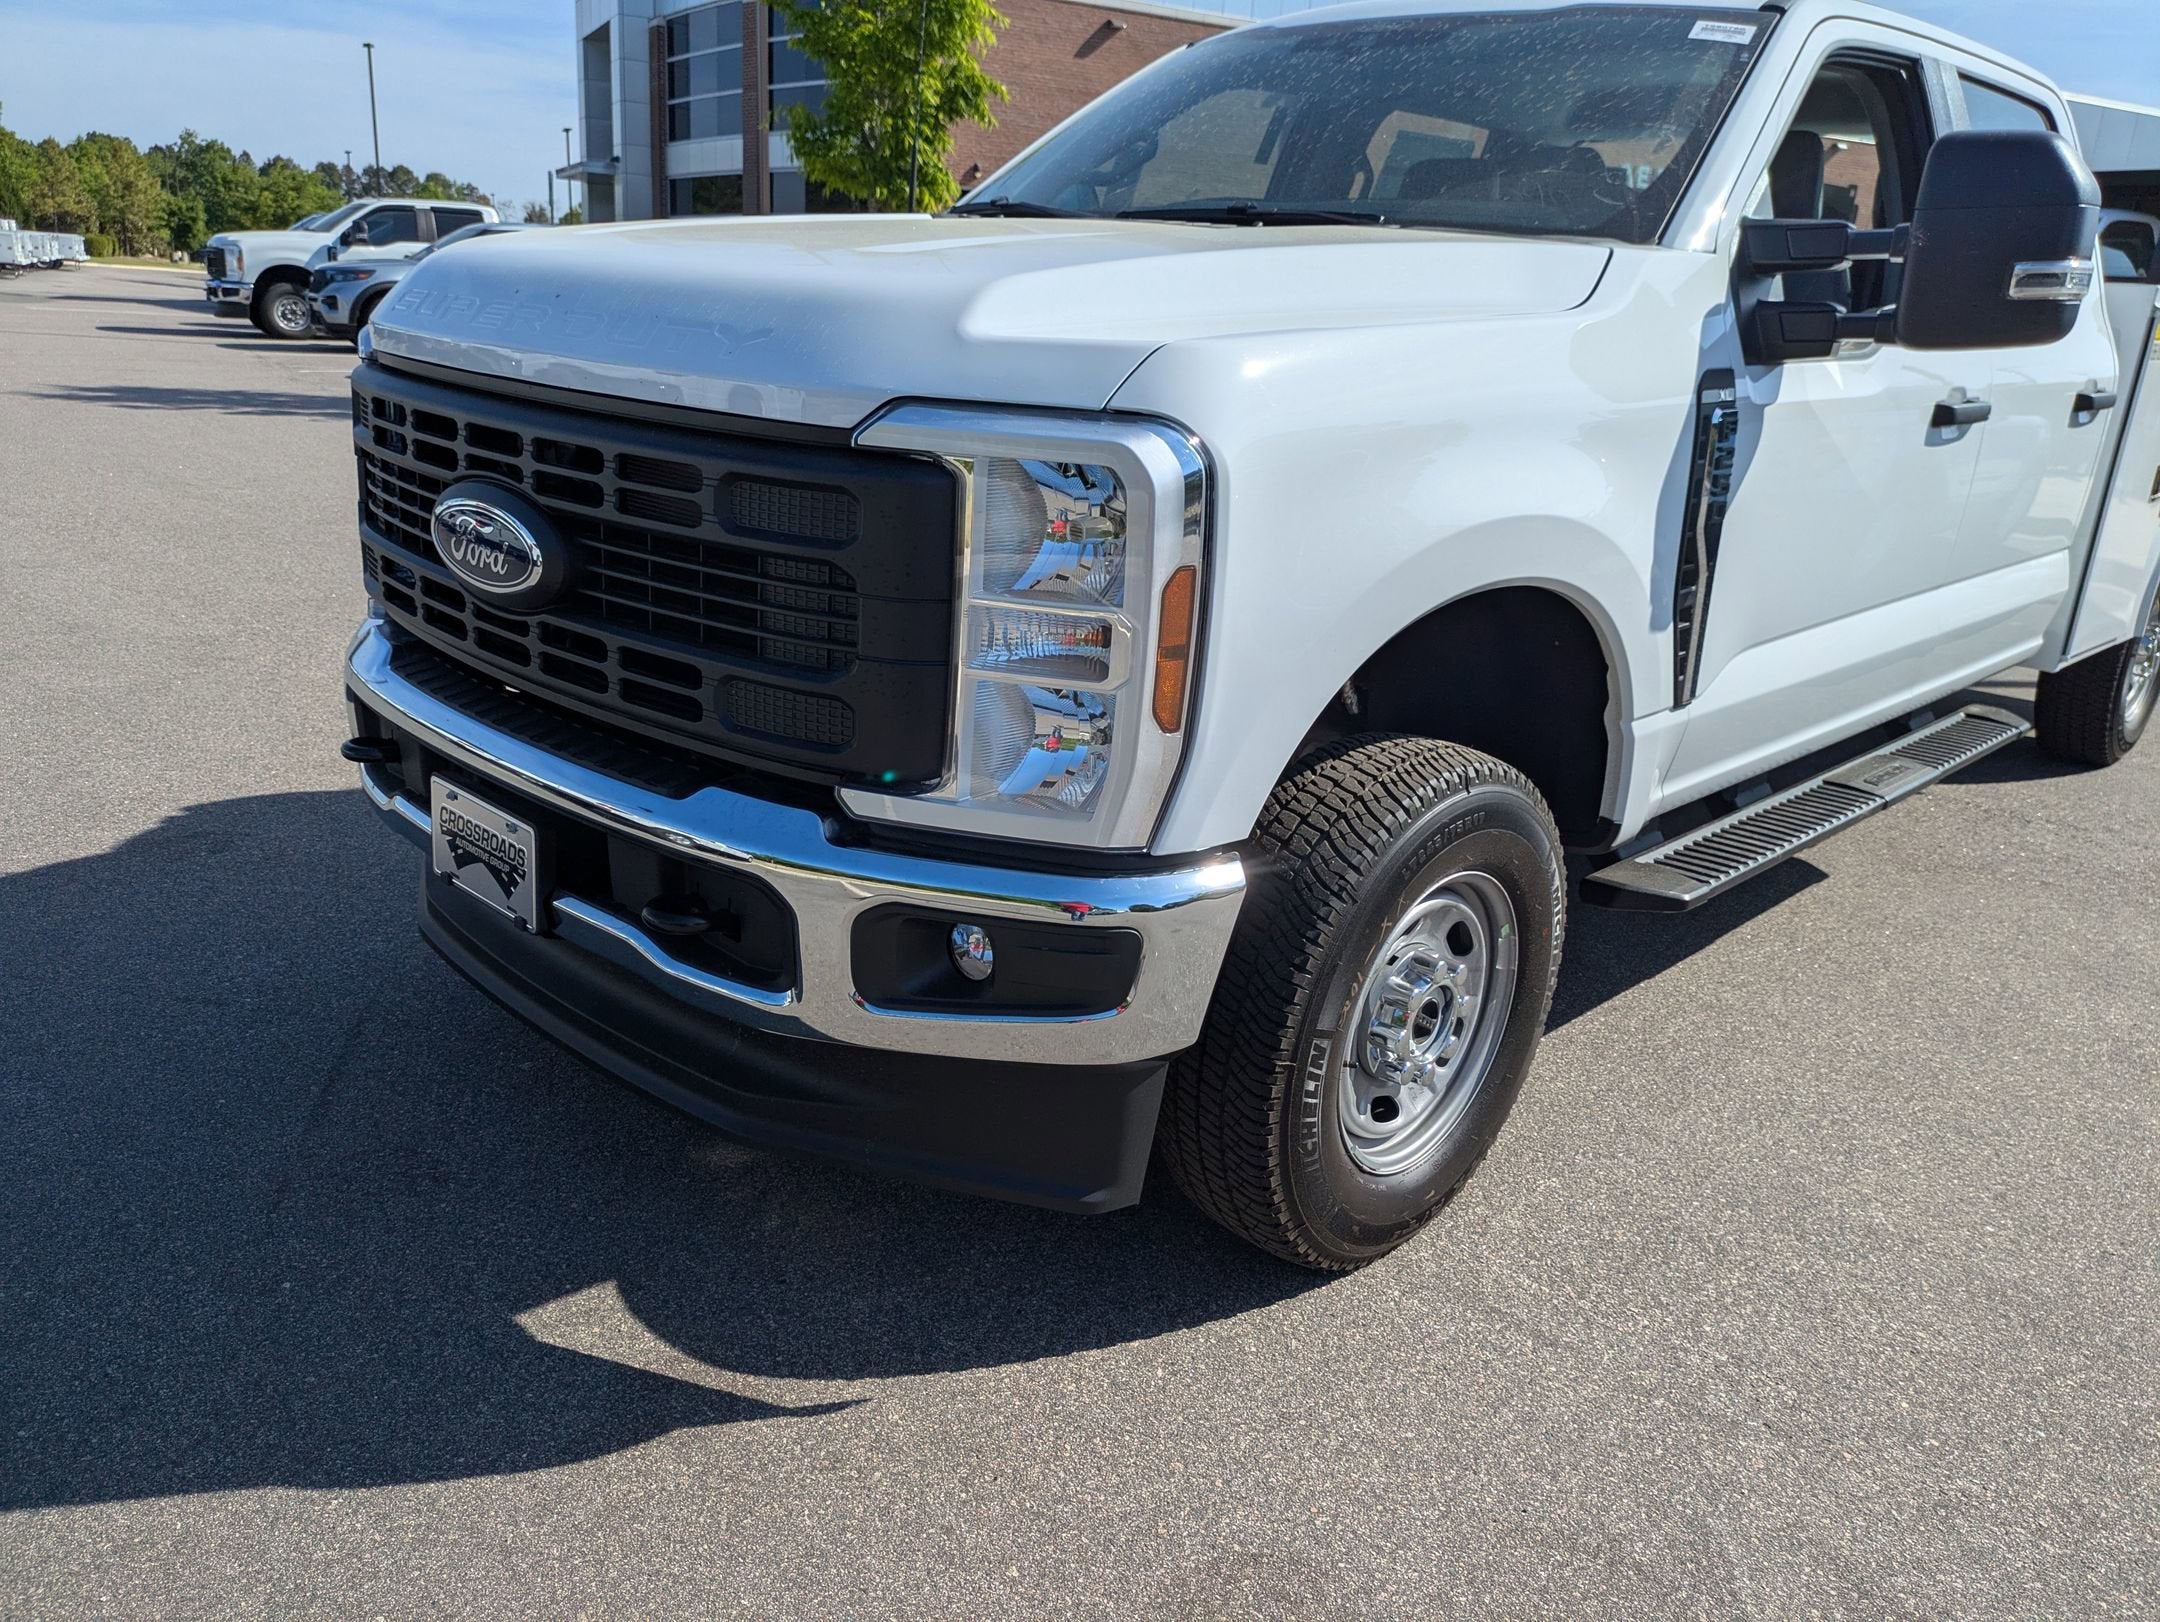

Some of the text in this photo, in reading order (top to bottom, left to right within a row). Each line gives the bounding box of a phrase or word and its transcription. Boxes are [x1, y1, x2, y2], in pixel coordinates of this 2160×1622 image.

[392, 288, 775, 360] SUPER DUTY
[450, 516, 509, 575] Ford
[440, 805, 527, 868] CROSSROADS
[455, 836, 510, 874] AUTOMOTIVE GROUP
